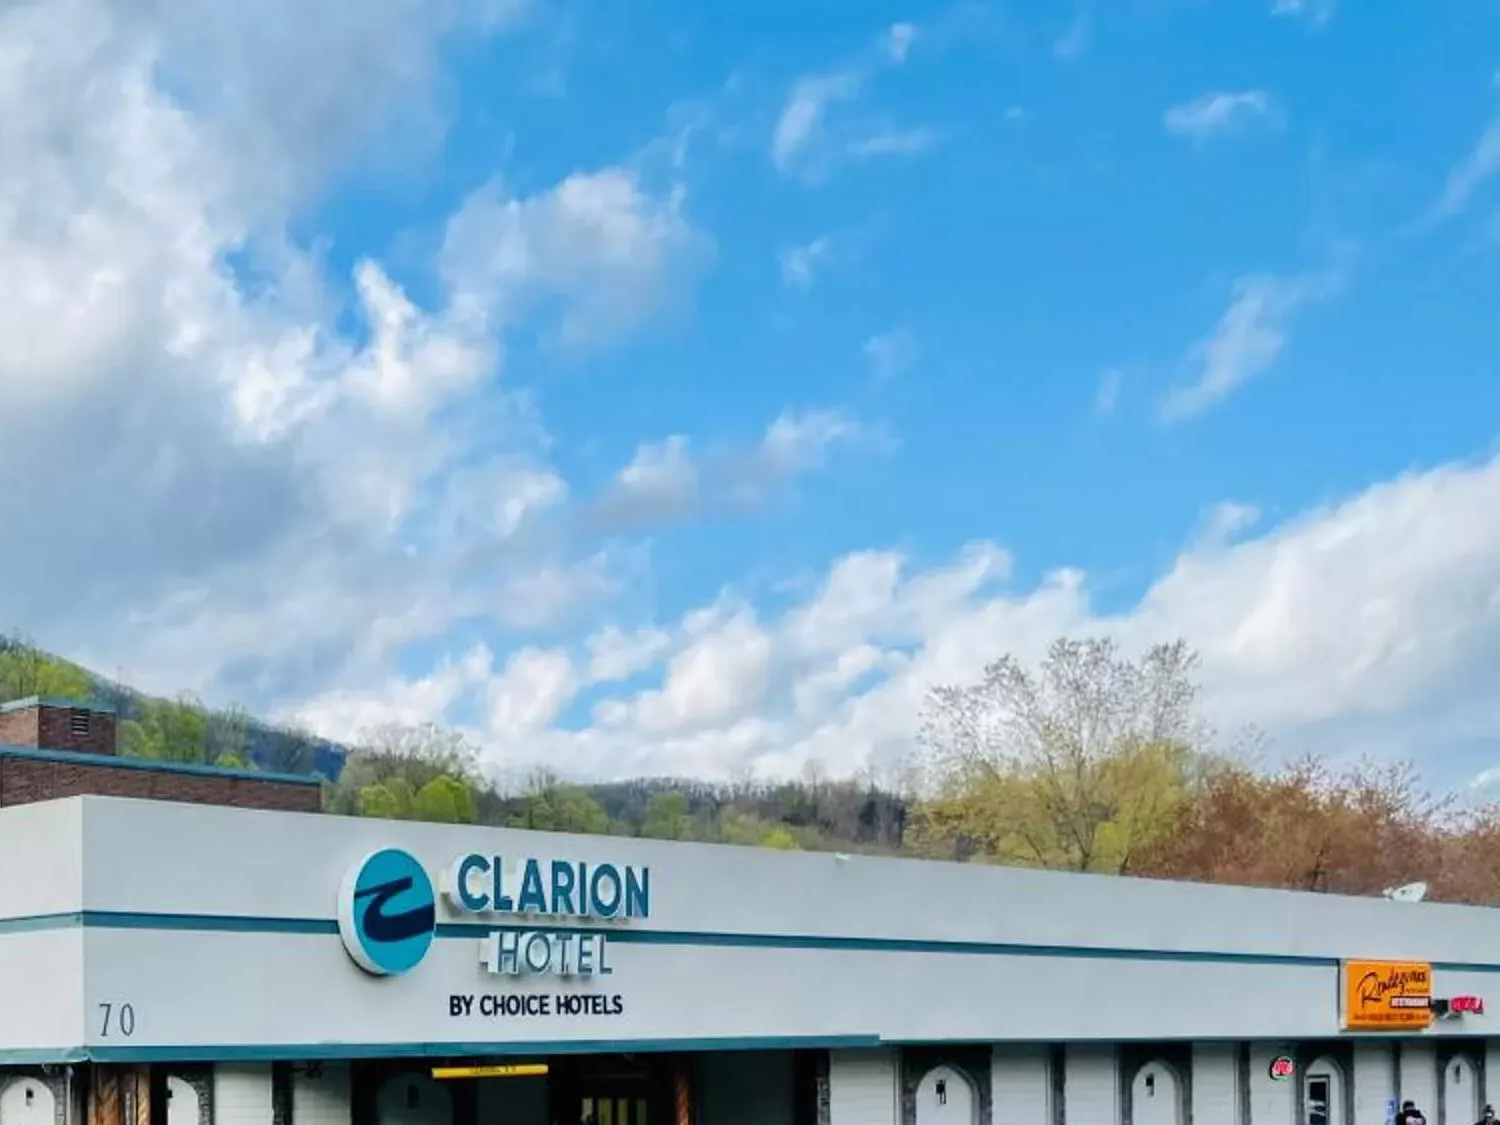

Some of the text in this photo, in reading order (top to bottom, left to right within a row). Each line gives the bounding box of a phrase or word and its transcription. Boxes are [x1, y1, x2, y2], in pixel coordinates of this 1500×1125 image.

[457, 854, 649, 918] CLARION
[498, 931, 613, 974] HOTEL
[100, 1003, 135, 1037] 70
[449, 995, 624, 1016] BY CHOICE HOTELS
